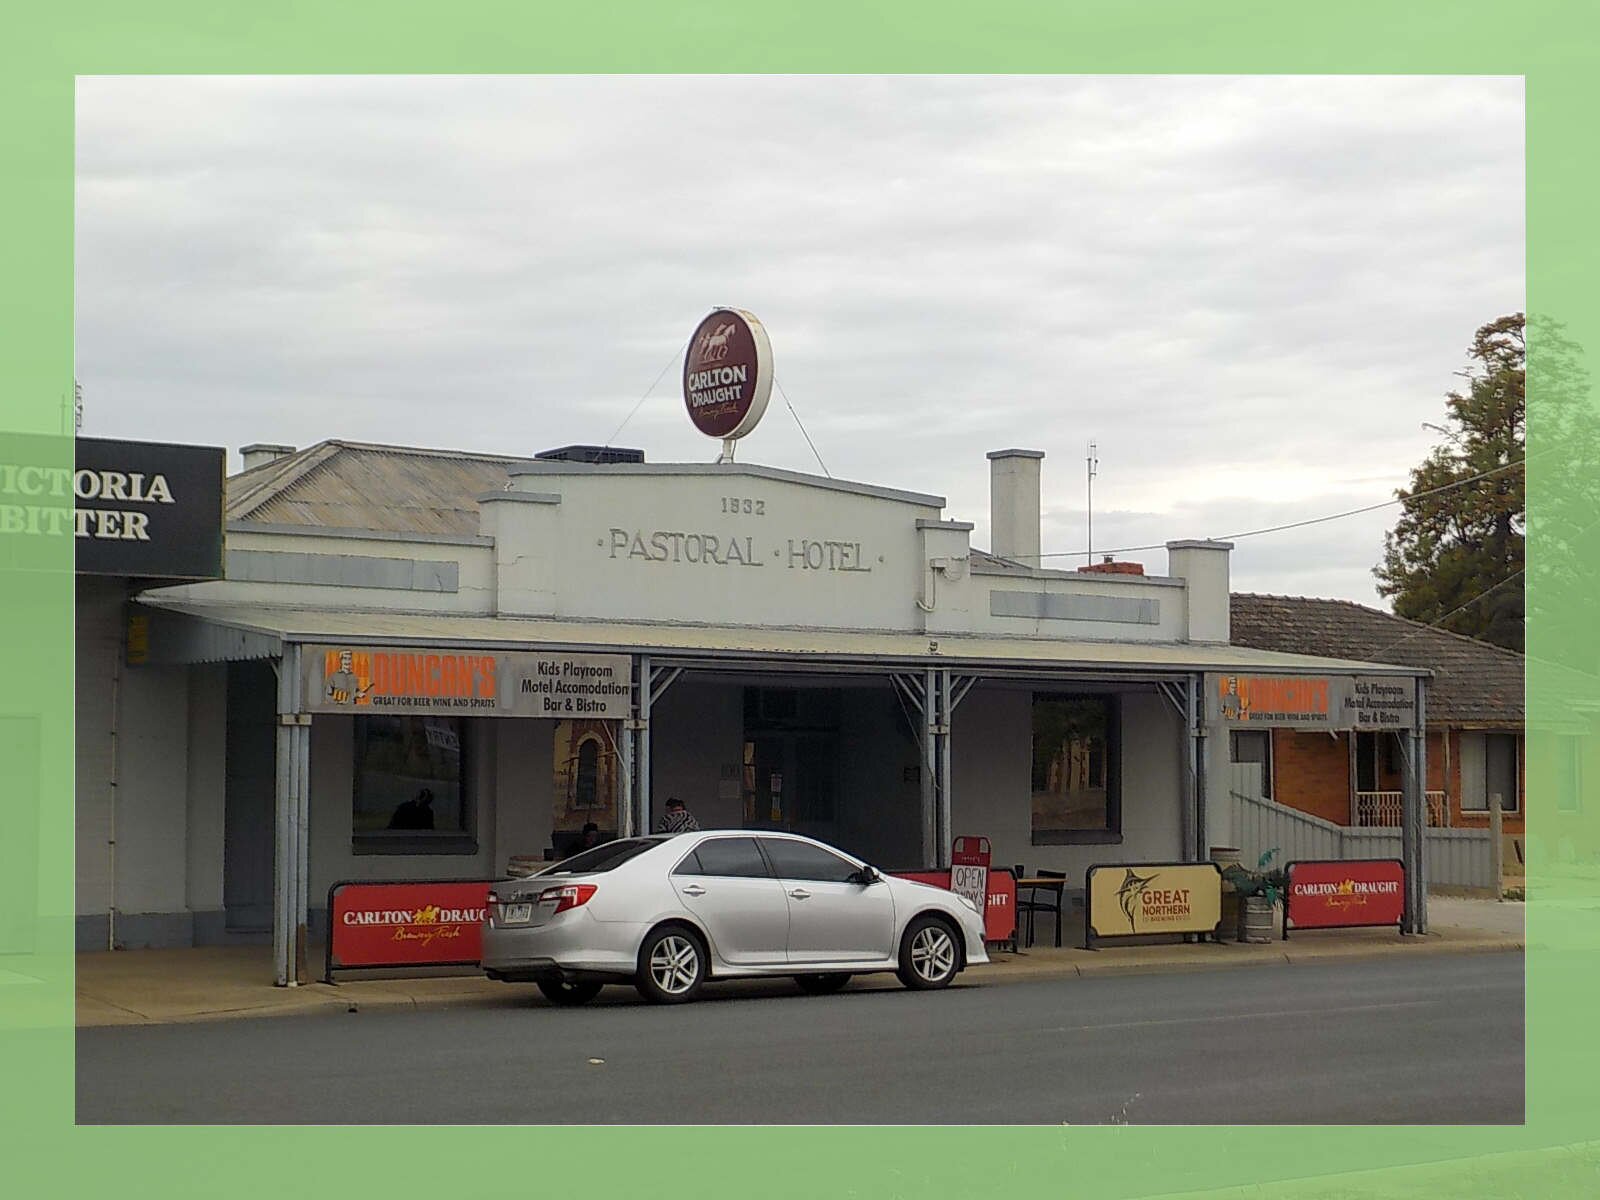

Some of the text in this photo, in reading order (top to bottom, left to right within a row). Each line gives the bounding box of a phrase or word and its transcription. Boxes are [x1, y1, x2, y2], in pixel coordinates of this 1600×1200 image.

[688, 364, 747, 392] CARLTON
[691, 384, 742, 408] DRAUGHT
[0, 464, 176, 503] ICTORIA
[0, 504, 151, 541] BITTER
[609, 528, 872, 572] PASTORAL HOTEL
[372, 652, 497, 698] DUNCAN'S
[538, 660, 612, 679] Kids Playroom
[521, 679, 629, 697] Motel Accomodation
[373, 696, 496, 708] GREAT FOR BEER WINE AND SPIRITS
[543, 697, 607, 712] Bar & Bistro
[956, 867, 984, 889] OPEN
[1142, 889, 1190, 905] GREAT
[1294, 881, 1399, 896] CARLTON DRAUGHT
[343, 908, 487, 925] CARLTON DRAUG
[1142, 904, 1190, 916] NORTHERN
